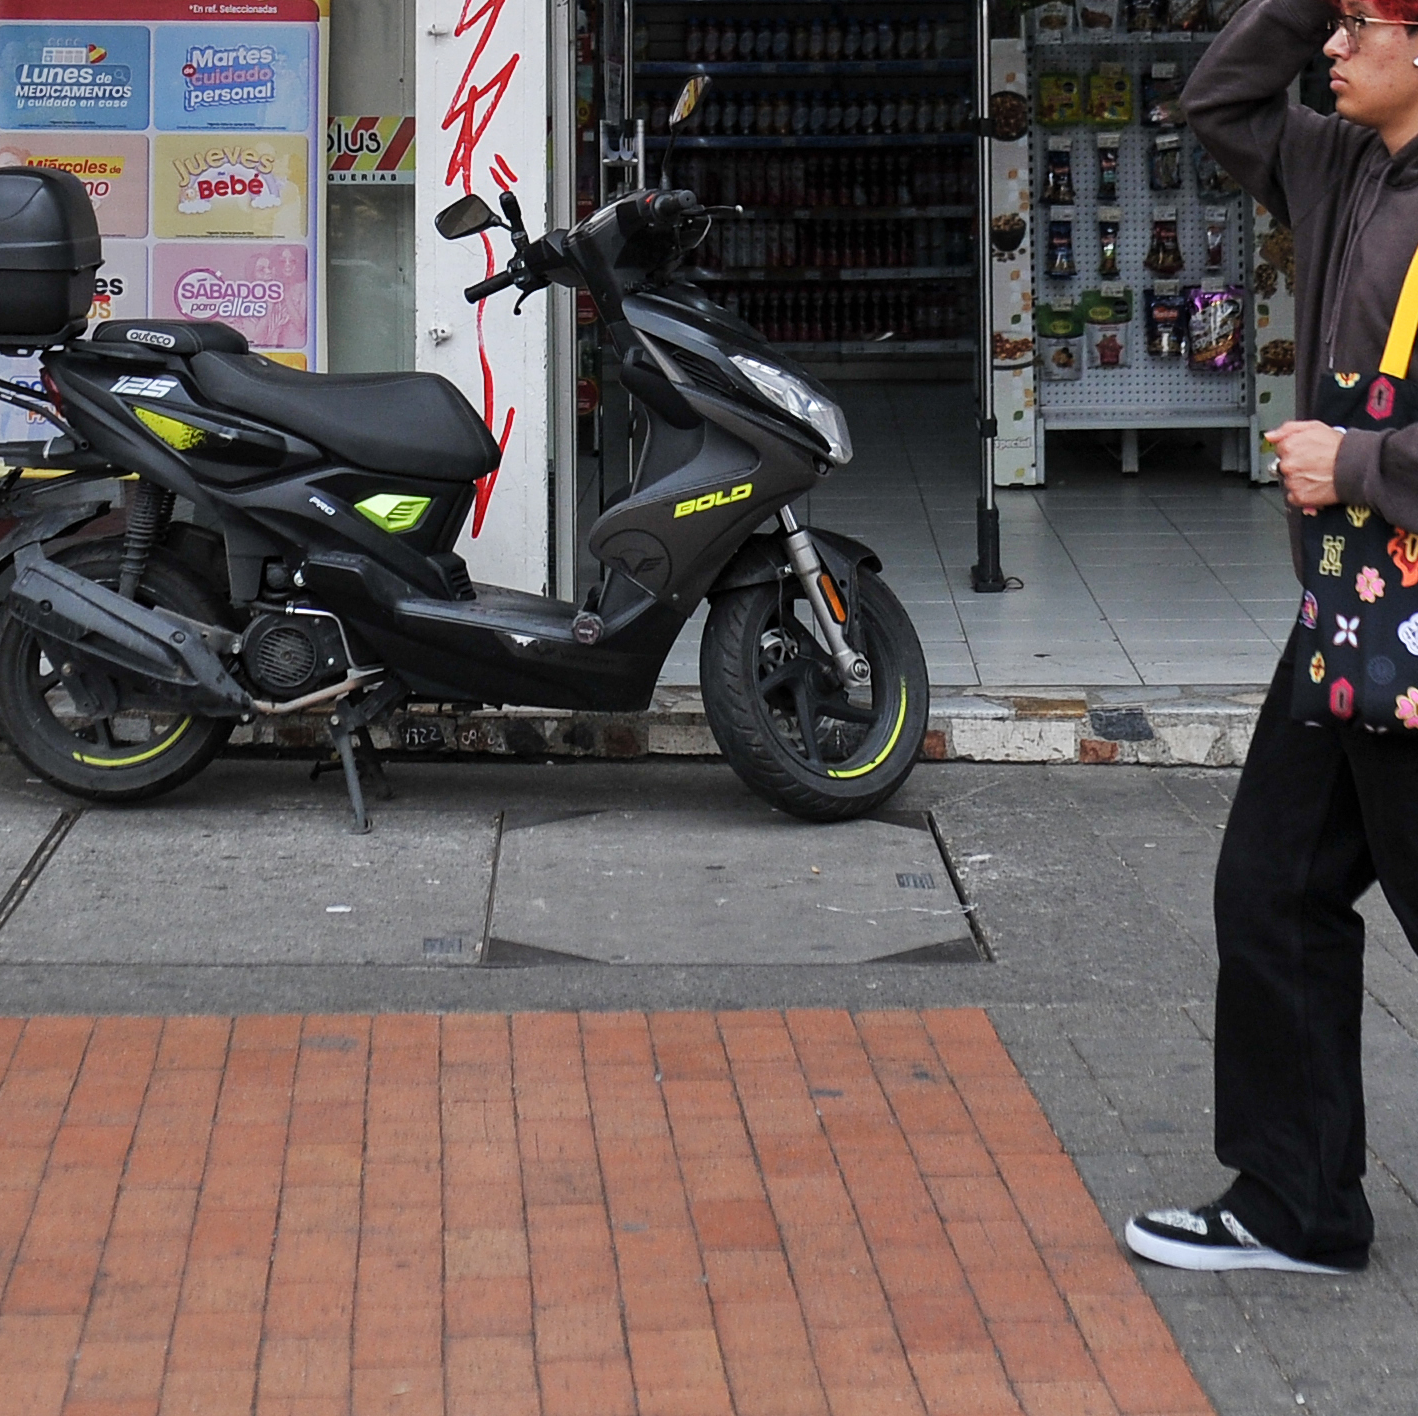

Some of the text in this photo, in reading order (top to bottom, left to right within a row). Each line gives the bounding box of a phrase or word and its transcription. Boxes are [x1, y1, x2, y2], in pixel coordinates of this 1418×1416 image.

[205, 4, 218, 14] ref.
[219, 4, 278, 14] Seleccionadas
[192, 47, 273, 68] Martes
[20, 64, 112, 84] Lunes de
[192, 66, 273, 85] cuidado
[15, 85, 132, 98] MEDICAMENTOS
[191, 82, 272, 106] personal
[17, 97, 128, 109] y cuidado en casa
[109, 166, 122, 174] de
[172, 146, 275, 188] Jueves
[197, 173, 264, 200] Bebé
[181, 278, 282, 300] SÁBADOS
[190, 296, 267, 317] para ellas
[130, 330, 172, 346] auteco
[110, 375, 179, 398] 125
[309, 496, 336, 516] PRO
[674, 483, 753, 519] BOLD
